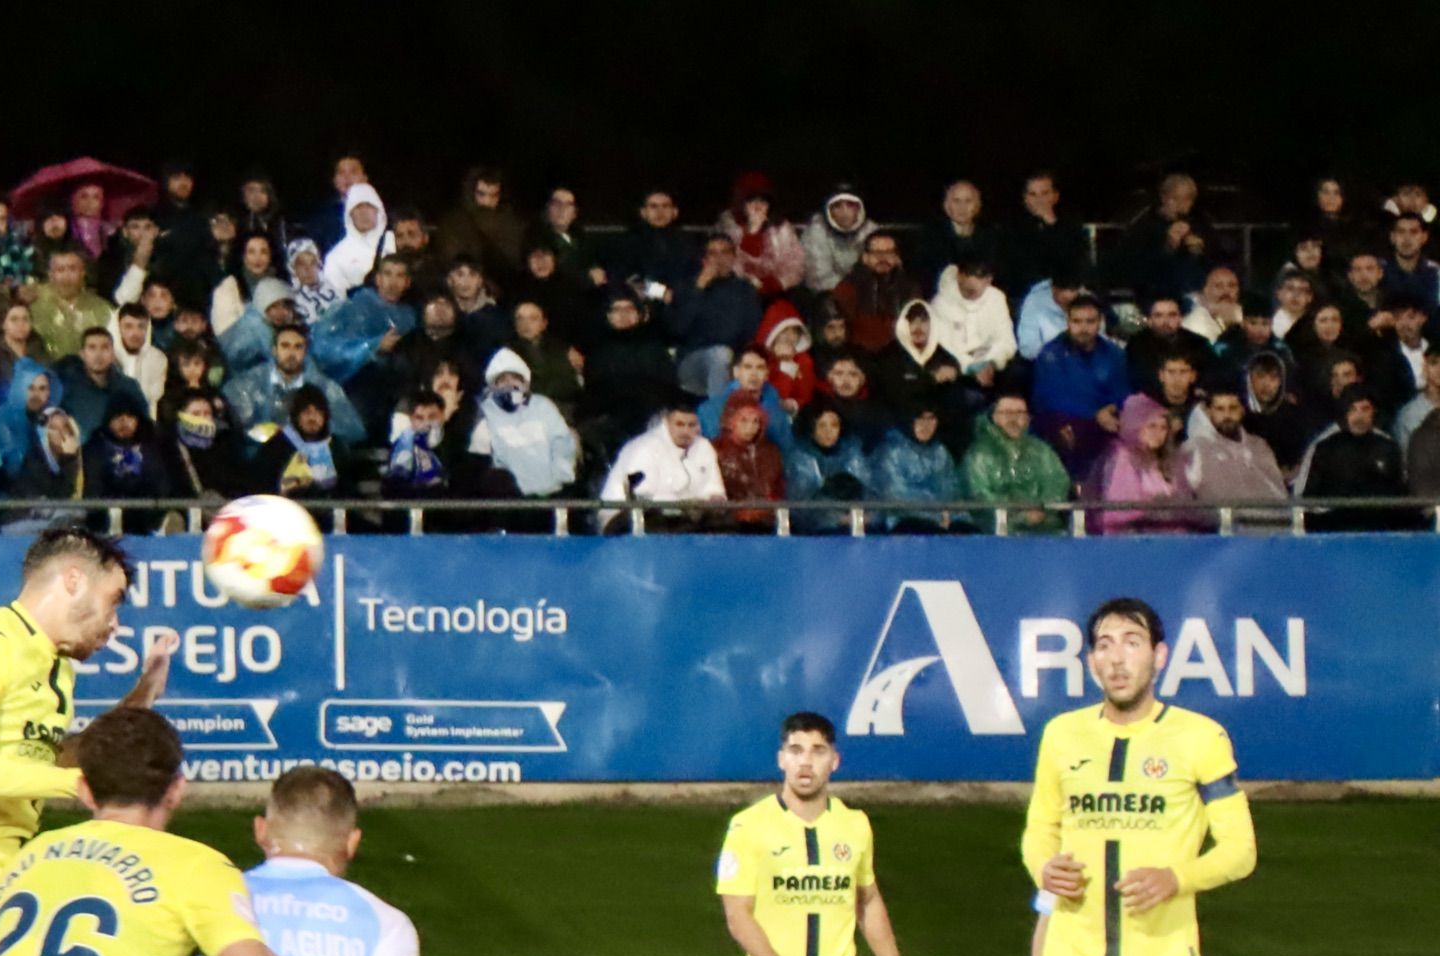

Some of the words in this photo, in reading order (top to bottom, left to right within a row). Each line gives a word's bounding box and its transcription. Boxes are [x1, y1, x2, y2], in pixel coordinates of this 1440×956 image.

[358, 597, 568, 642] Tecnología
[72, 624, 282, 682] SPEJO
[846, 579, 1308, 735] ARAN
[165, 714, 245, 734] ampion
[336, 713, 392, 737] sage
[1068, 792, 1167, 815] PAMESA
[44, 838, 159, 904] NAVARRO
[772, 875, 852, 891] PAMESA
